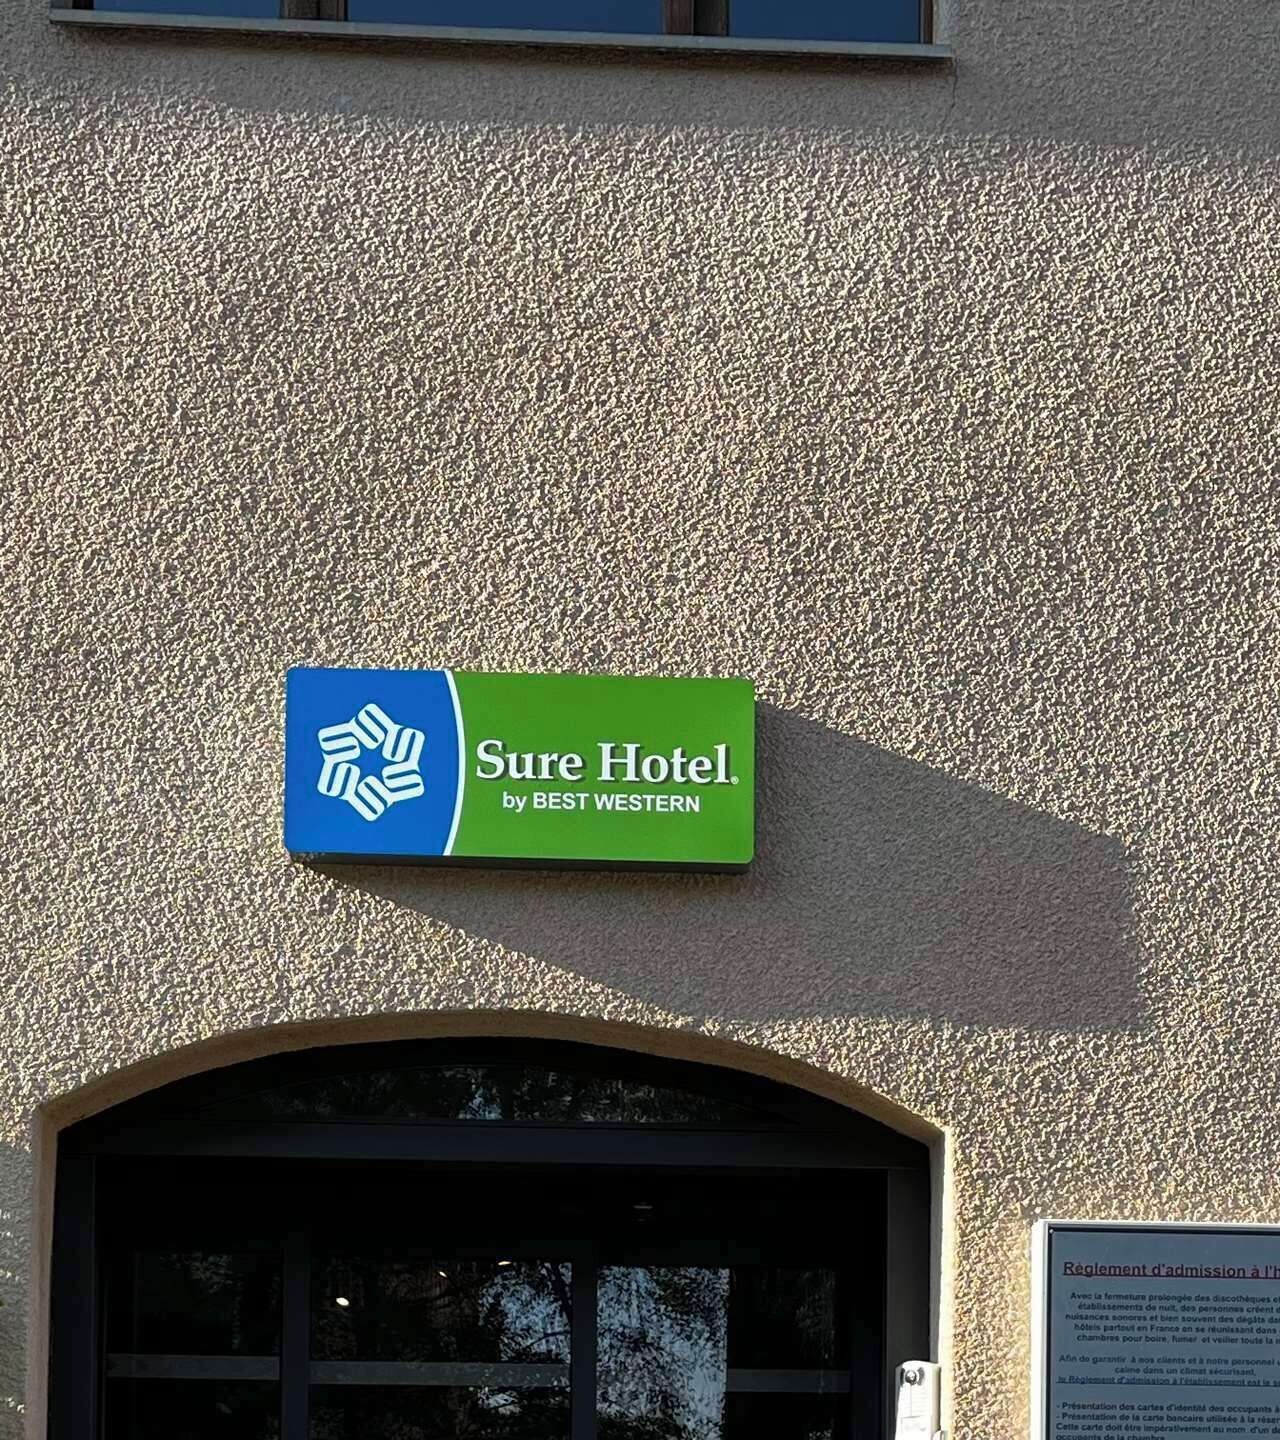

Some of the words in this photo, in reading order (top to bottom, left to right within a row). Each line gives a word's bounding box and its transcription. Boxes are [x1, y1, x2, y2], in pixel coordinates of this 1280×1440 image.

[476, 740, 586, 782] Sure
[598, 743, 732, 784] Hotel
[503, 792, 527, 812] by
[533, 793, 588, 810] BEST
[593, 794, 700, 813] WESTERN
